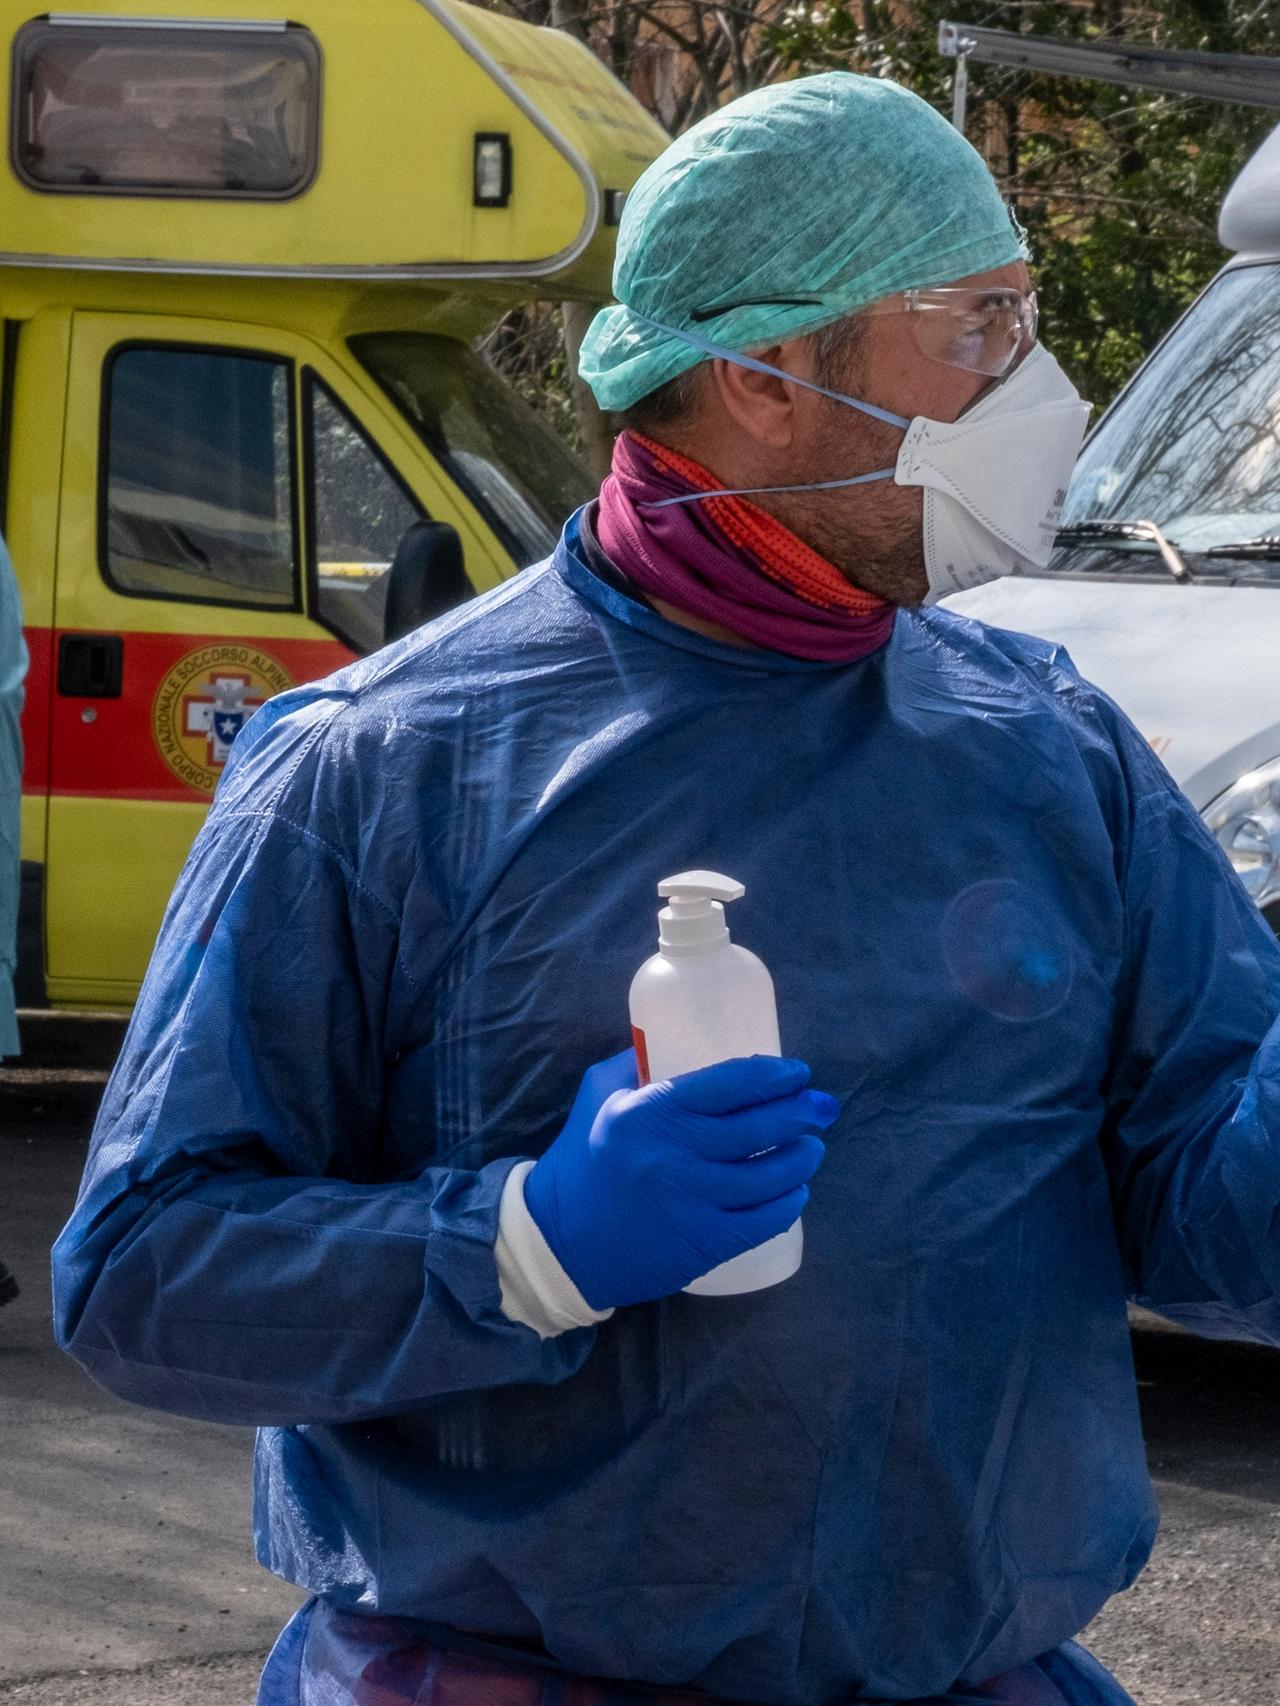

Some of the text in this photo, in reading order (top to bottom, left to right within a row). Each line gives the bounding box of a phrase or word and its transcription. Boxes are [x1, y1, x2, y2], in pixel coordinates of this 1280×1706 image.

[177, 648, 249, 679] SOCCORSO
[158, 679, 180, 755] NAZIONALE
[171, 756, 213, 788] CORPO
